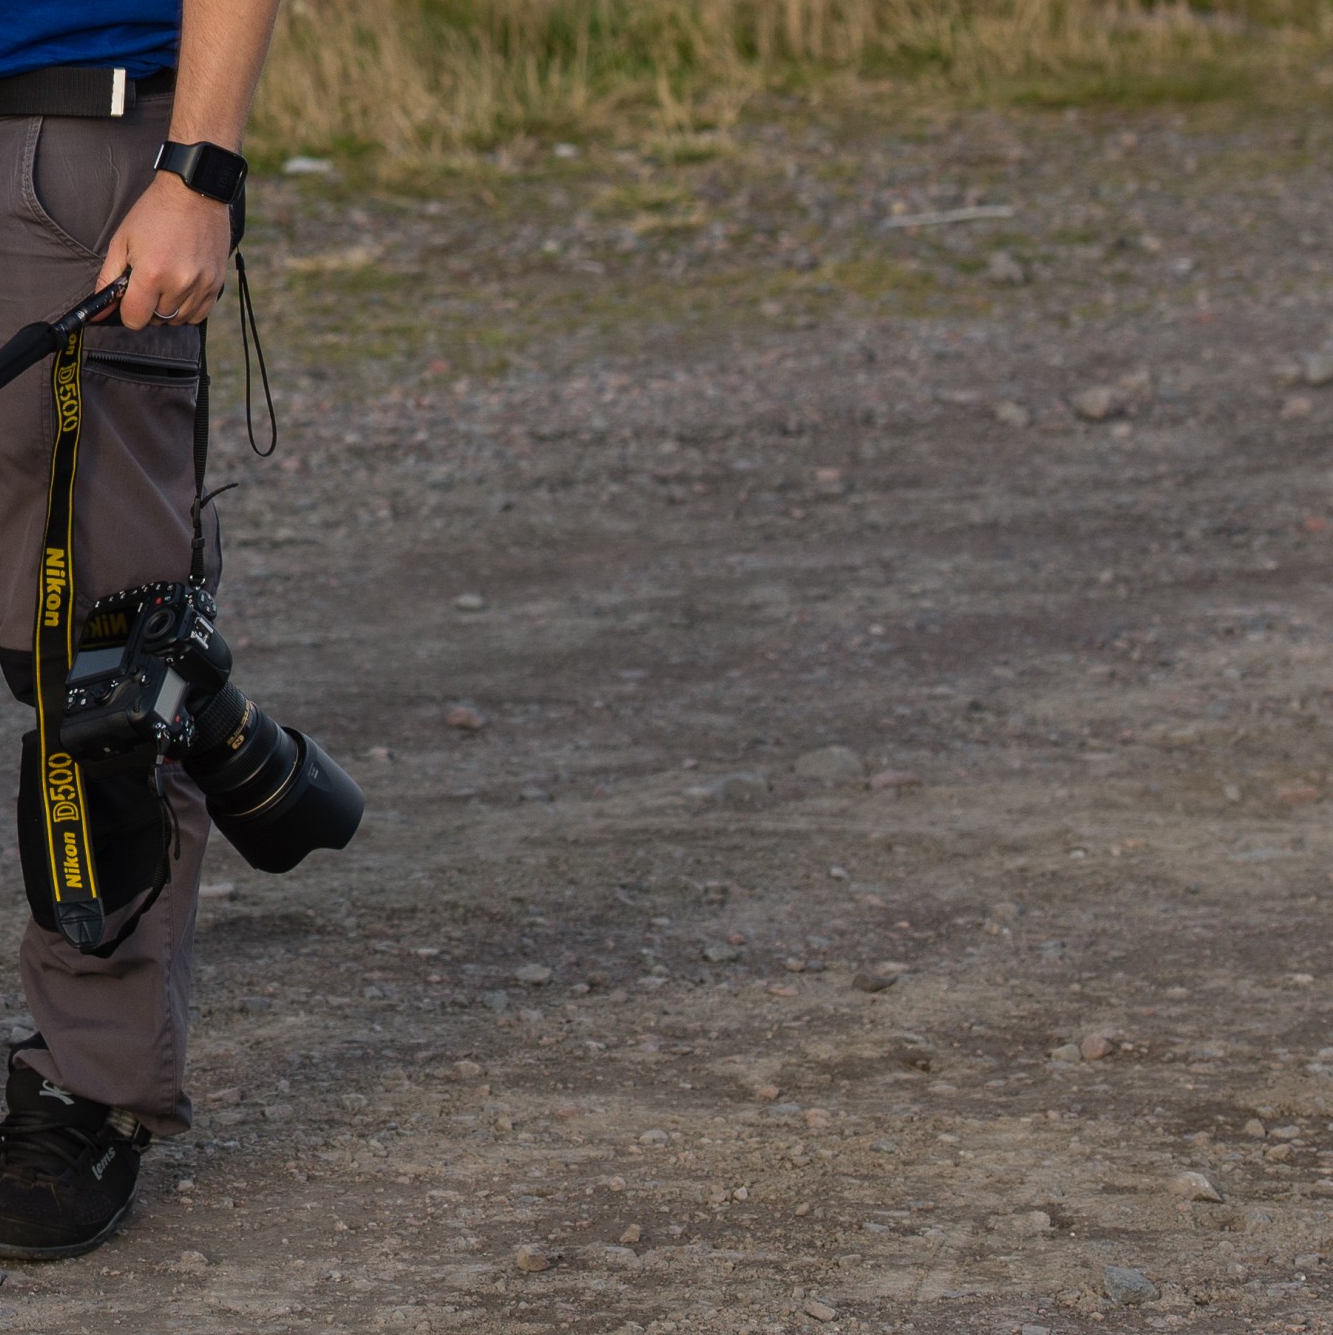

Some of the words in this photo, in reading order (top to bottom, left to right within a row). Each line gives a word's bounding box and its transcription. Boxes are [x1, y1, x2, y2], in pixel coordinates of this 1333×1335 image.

[58, 362, 79, 433] D500
[44, 547, 66, 627] Nikon
[48, 752, 80, 823] D500
[63, 831, 83, 889] Nikon
[92, 1146, 115, 1180] Lems
